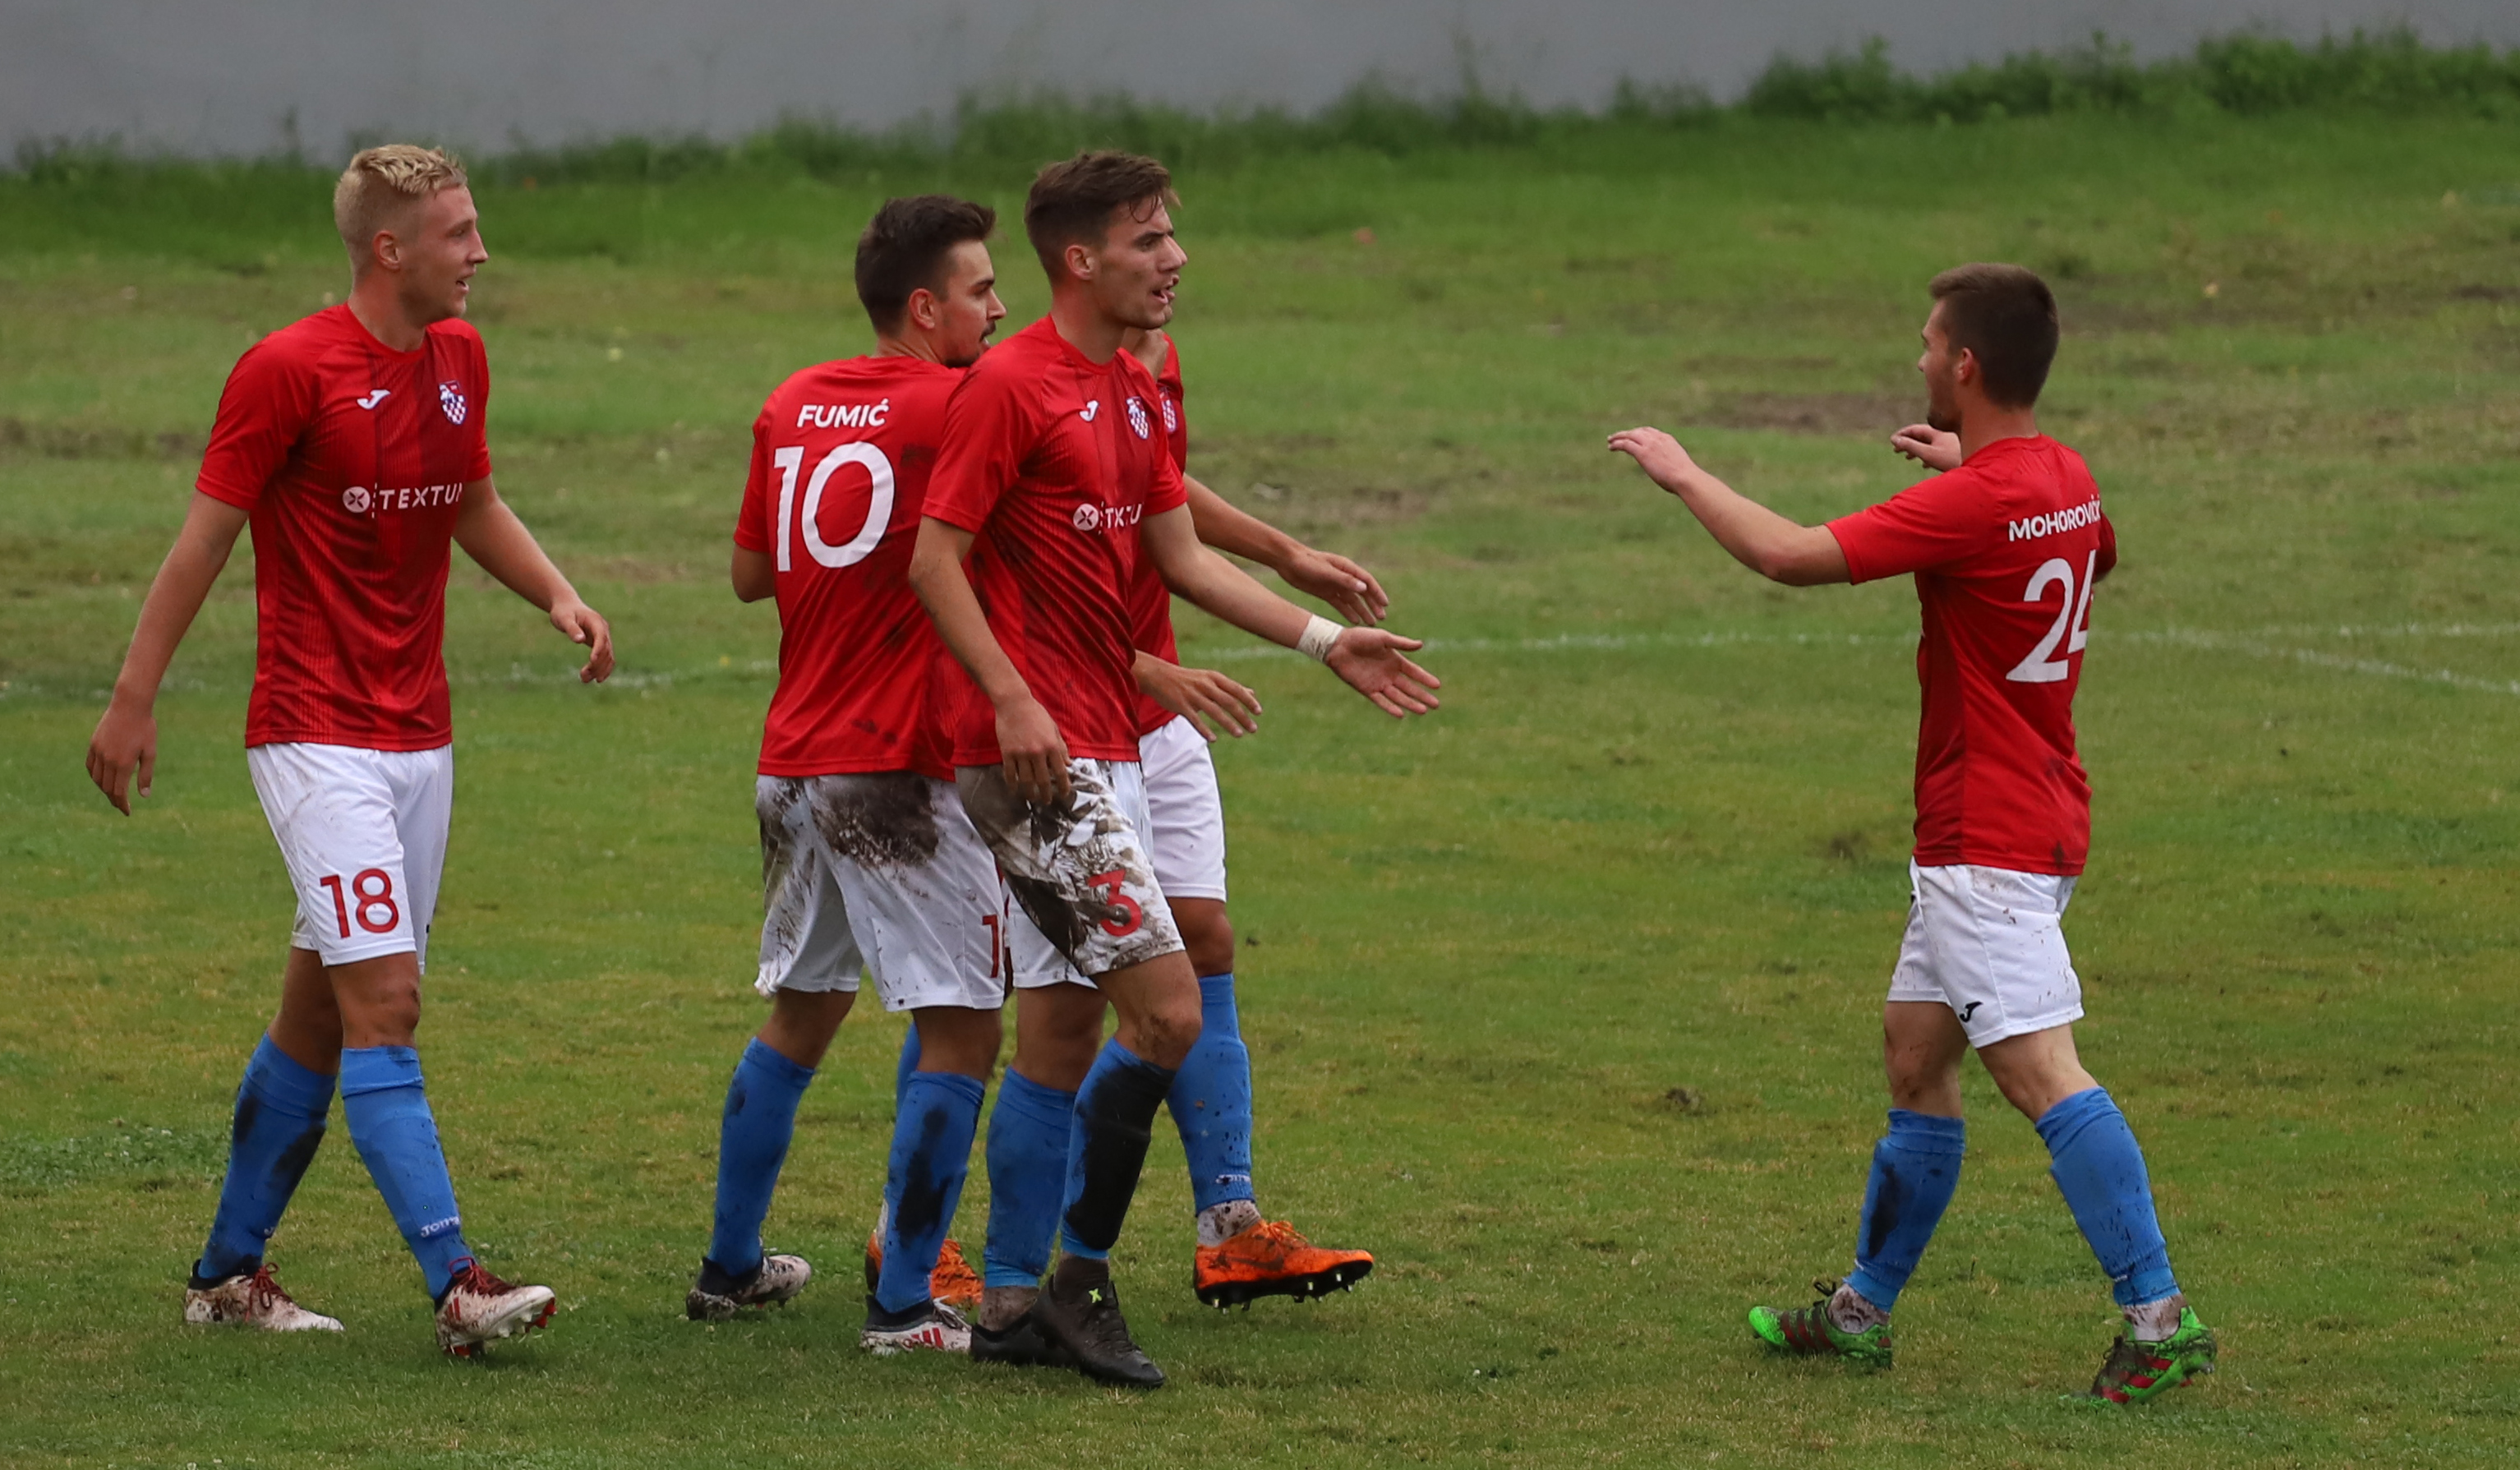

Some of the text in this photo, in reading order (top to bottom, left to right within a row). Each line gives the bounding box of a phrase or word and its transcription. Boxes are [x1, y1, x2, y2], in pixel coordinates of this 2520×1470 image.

[796, 398, 890, 428] FUMIĆ
[774, 441, 896, 571] 10
[320, 868, 399, 938] 18
[1087, 868, 1142, 937] 3
